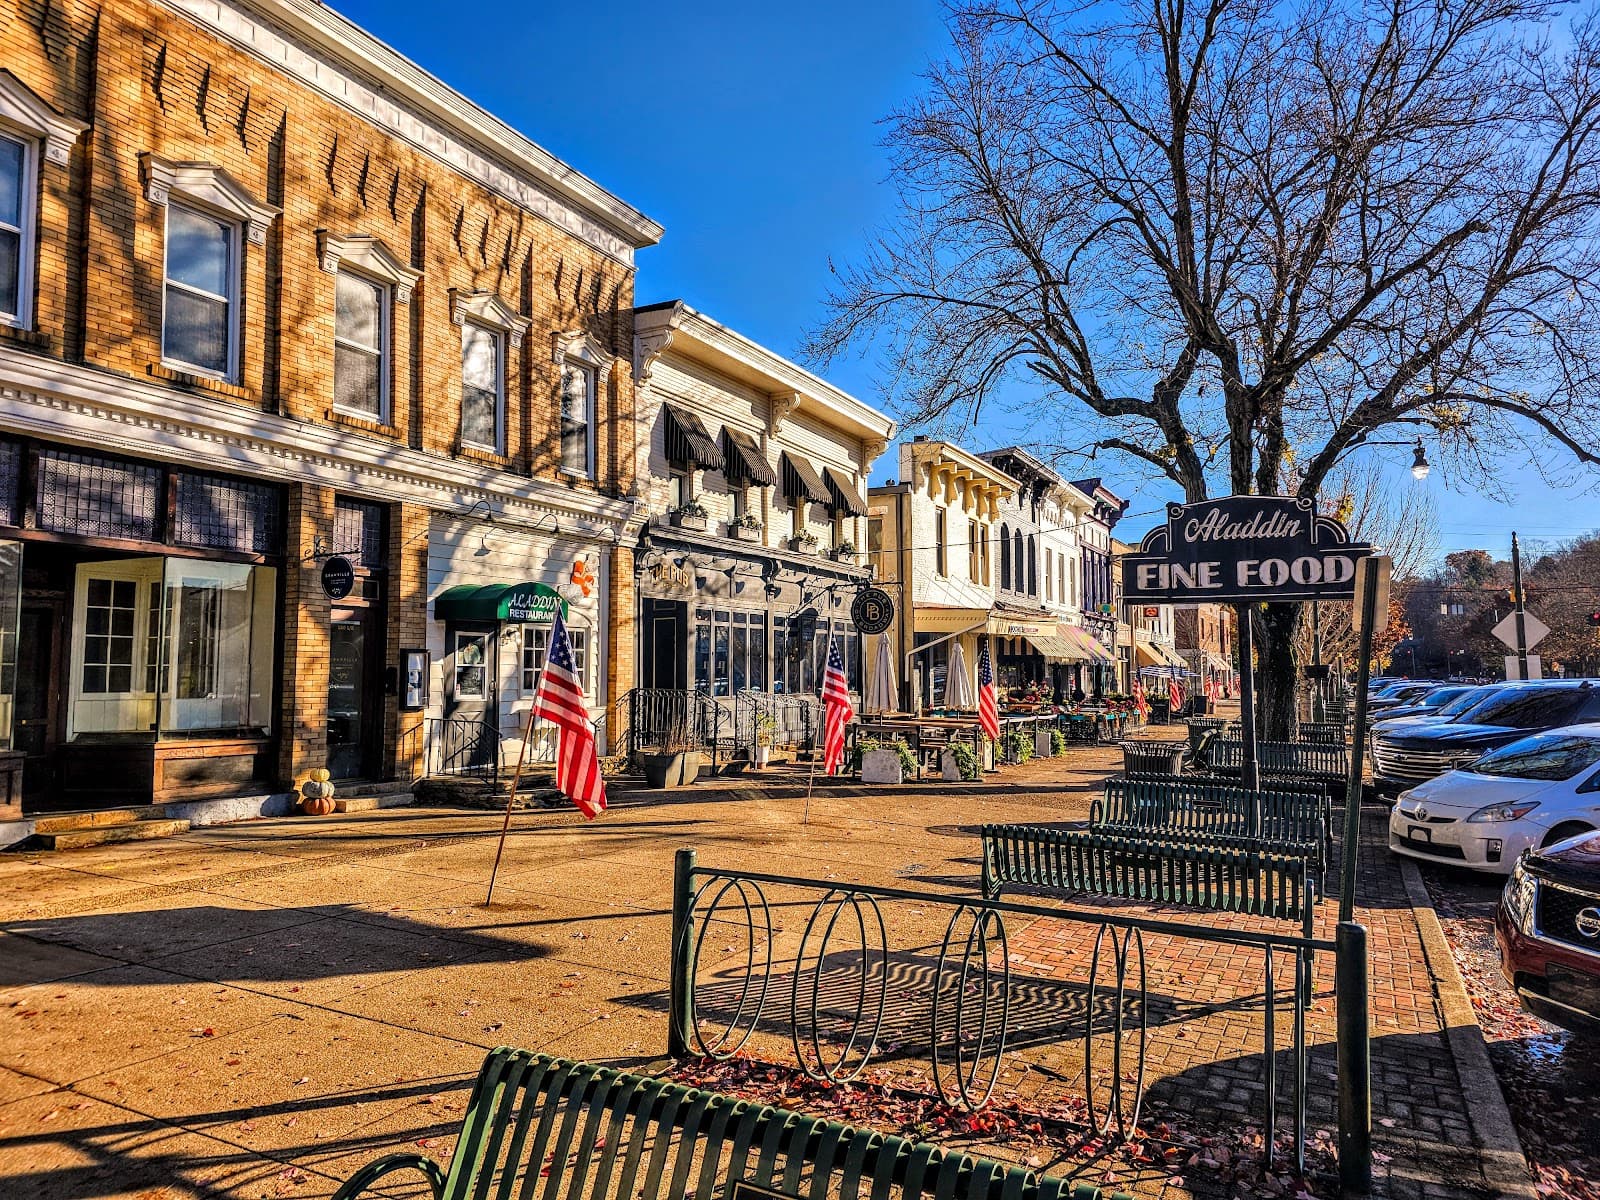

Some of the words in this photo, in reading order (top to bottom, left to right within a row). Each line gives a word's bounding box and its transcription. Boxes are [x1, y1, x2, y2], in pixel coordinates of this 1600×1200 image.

[1184, 507, 1305, 543] Aladdin
[670, 563, 689, 588] PUB
[1136, 561, 1224, 591] FINE
[1236, 555, 1355, 587] FOOD
[508, 593, 562, 610] ALADDIN
[873, 592, 887, 604] PUB
[509, 608, 556, 620] RESTAURAN
